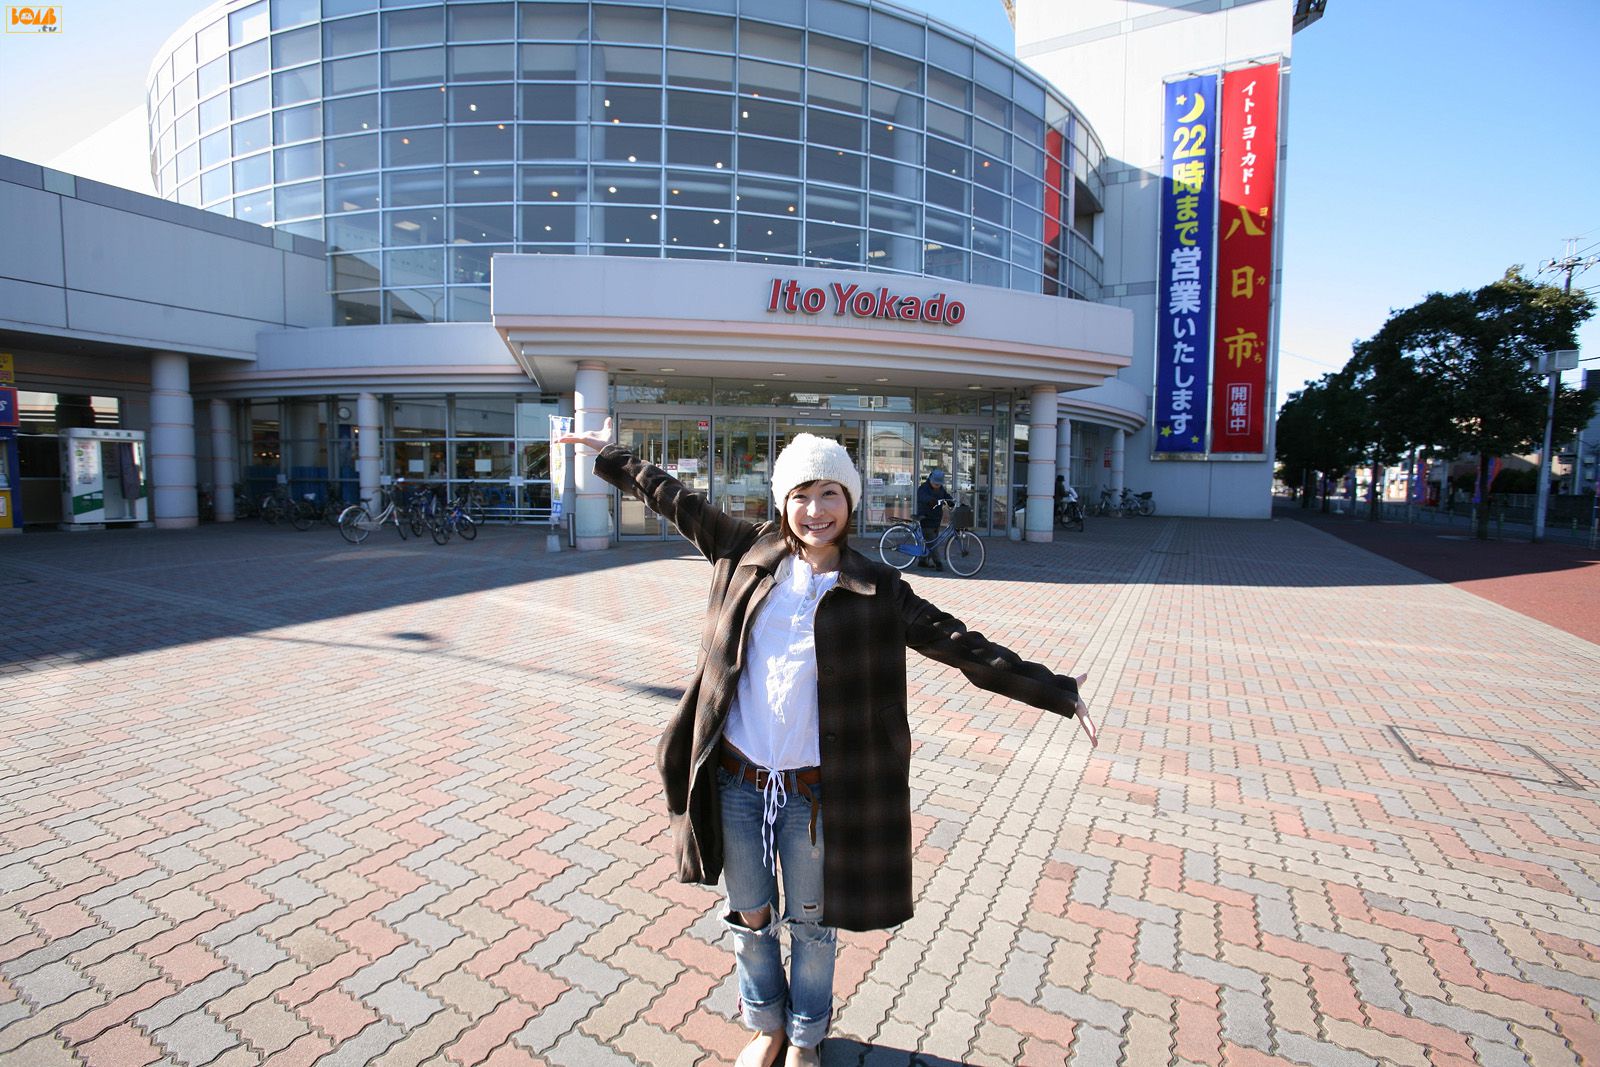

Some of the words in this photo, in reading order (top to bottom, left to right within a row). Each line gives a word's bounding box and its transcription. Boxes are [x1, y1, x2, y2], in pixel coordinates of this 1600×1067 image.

[1240, 80, 1257, 195] イトーヨーカドー
[830, 281, 965, 326] Yokado
[1230, 386, 1249, 431] 開催中
